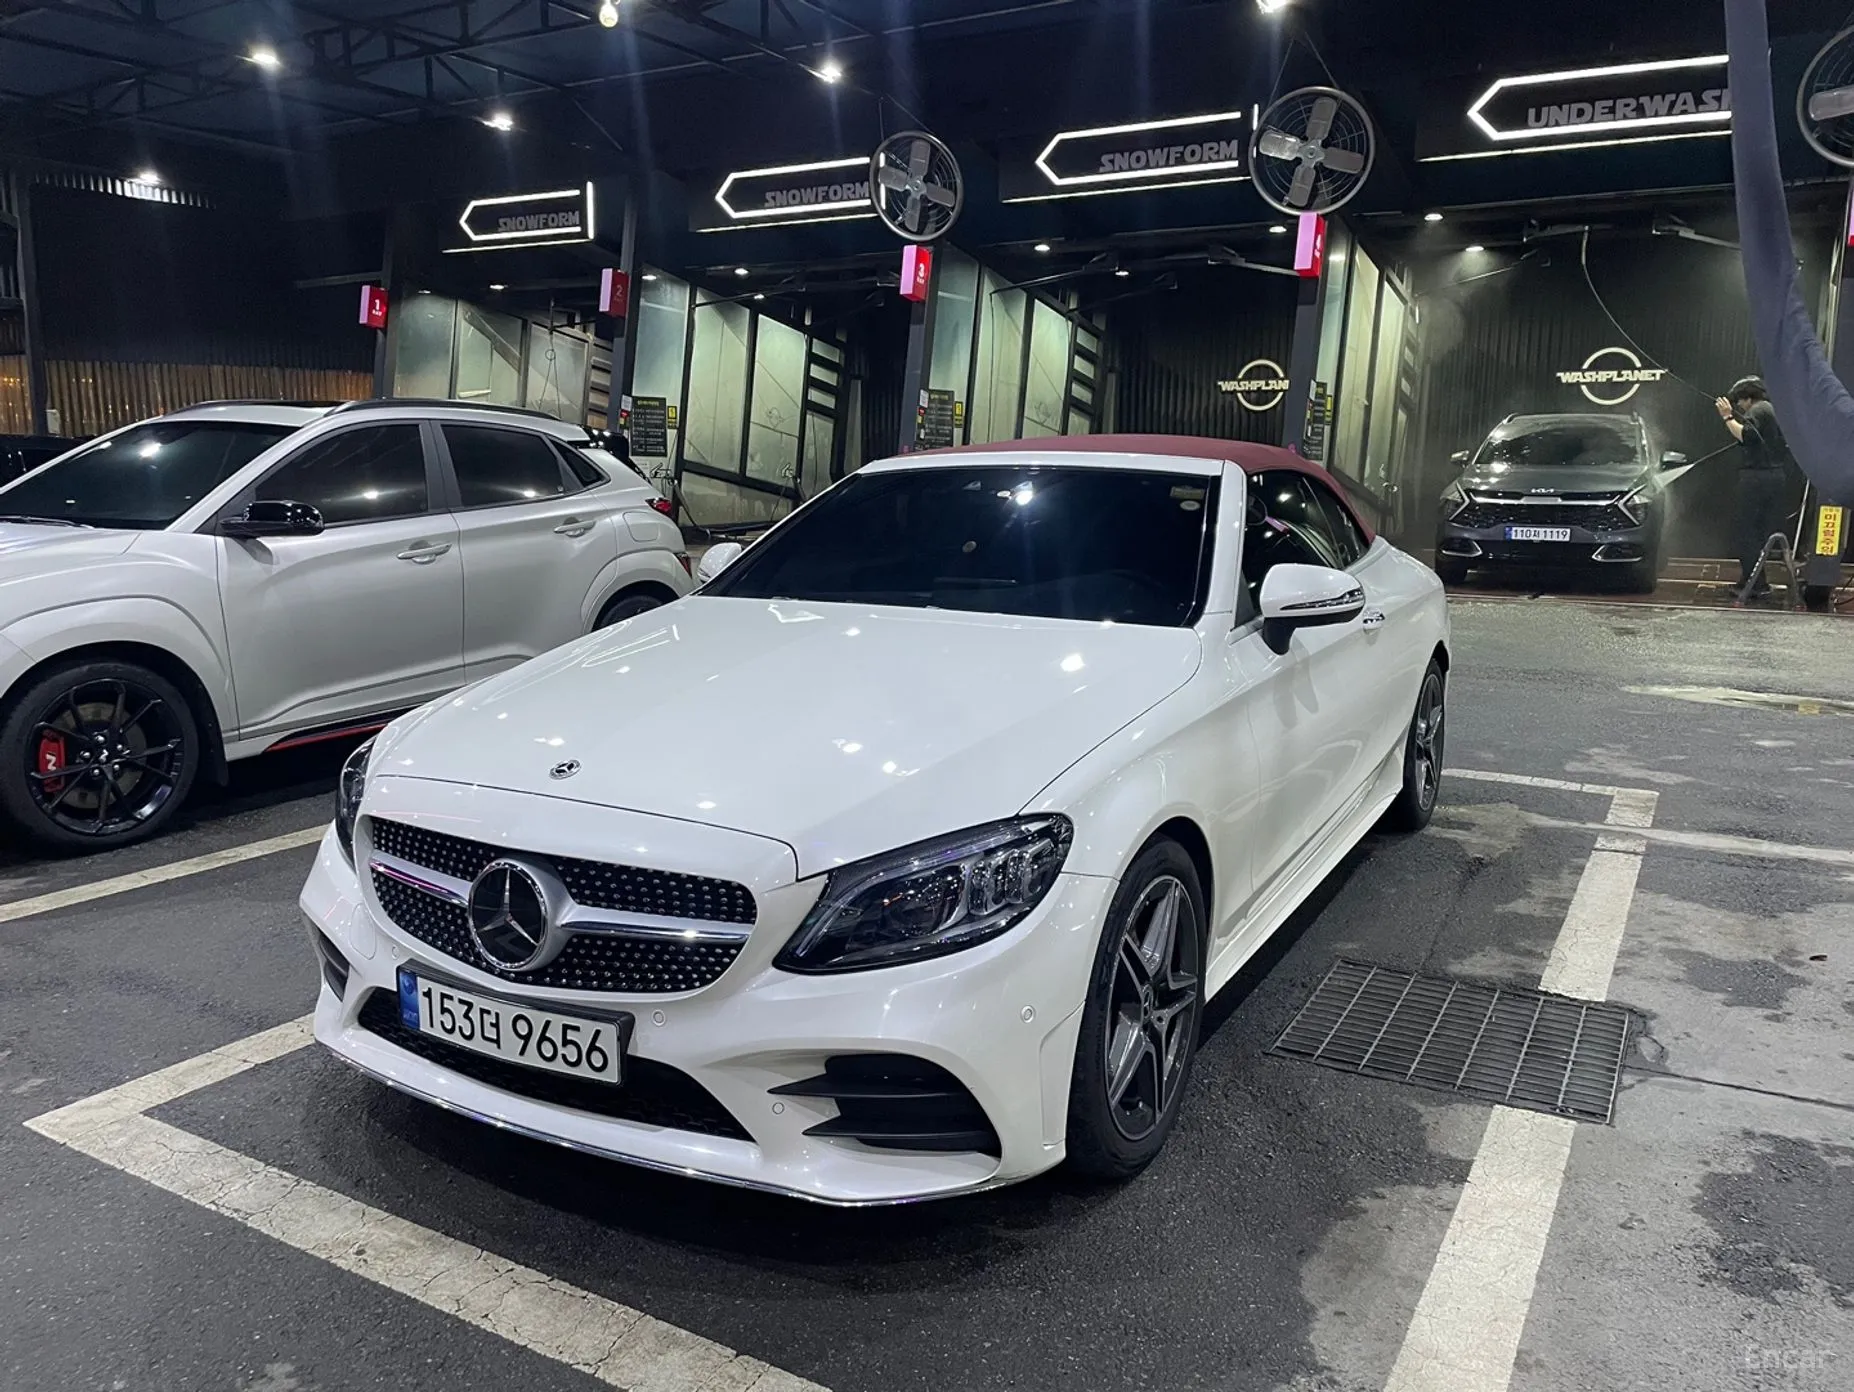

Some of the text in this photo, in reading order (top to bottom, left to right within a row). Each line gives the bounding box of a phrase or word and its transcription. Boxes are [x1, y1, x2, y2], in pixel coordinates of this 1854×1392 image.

[1099, 139, 1239, 173] SNOWFORM
[764, 181, 870, 208] SNOWFORM
[498, 210, 580, 232] SNOWFORM
[918, 262, 925, 278] 3
[616, 284, 623, 297] 2
[374, 299, 380, 310] 1
[1556, 369, 1664, 383] WASHPLANET
[1543, 530, 1568, 539] 1119
[422, 987, 609, 1073] 153더 9656
